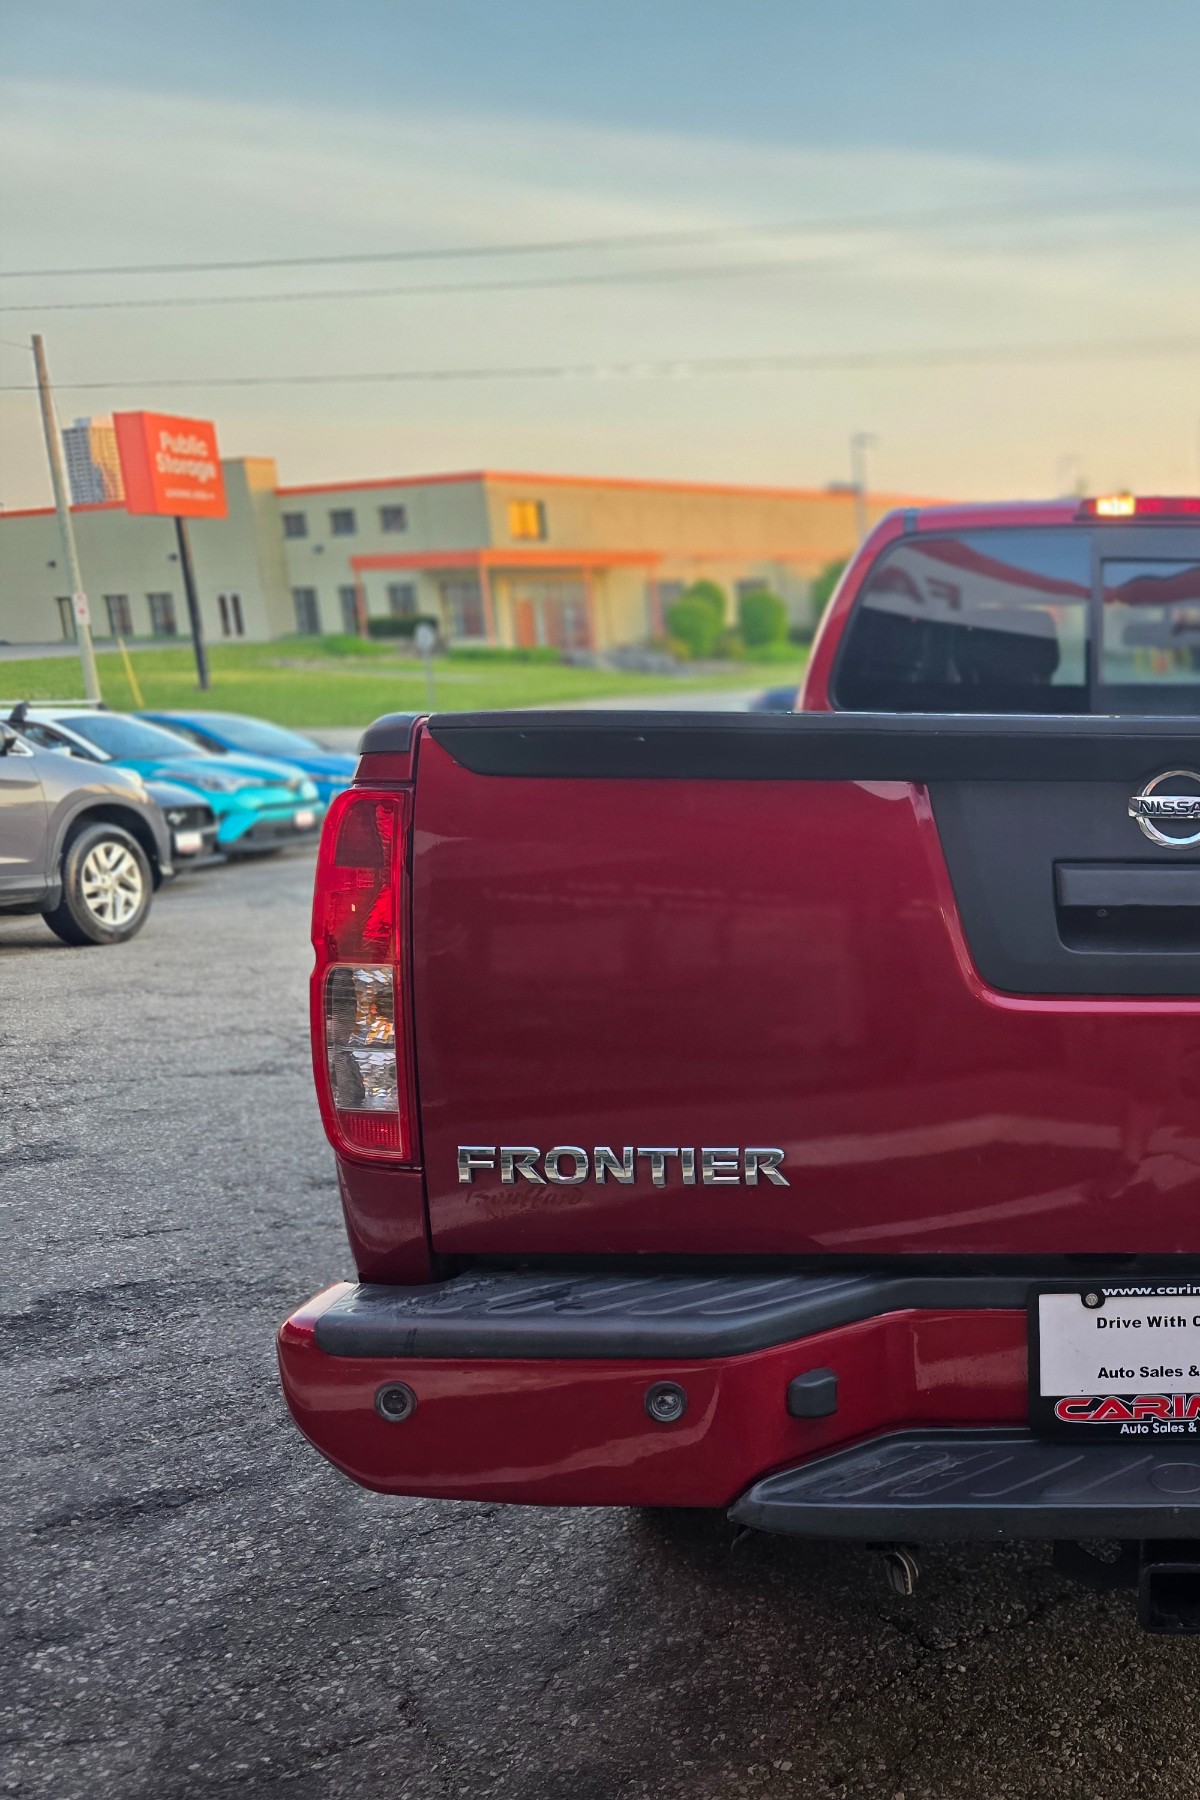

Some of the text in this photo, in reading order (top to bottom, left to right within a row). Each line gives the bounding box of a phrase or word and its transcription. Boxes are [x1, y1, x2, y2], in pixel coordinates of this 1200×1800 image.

[159, 430, 208, 457] Public
[156, 451, 217, 484] Storage
[457, 1145, 791, 1187] FRONTIER
[1096, 1316, 1142, 1329] Drive
[1146, 1315, 1187, 1328] With
[1097, 1367, 1135, 1379] Auto
[1139, 1365, 1184, 1378] Sales
[1188, 1365, 1200, 1378] &
[1120, 1422, 1149, 1434] Auto
[1152, 1421, 1184, 1434] Sales
[1188, 1422, 1197, 1433] &
